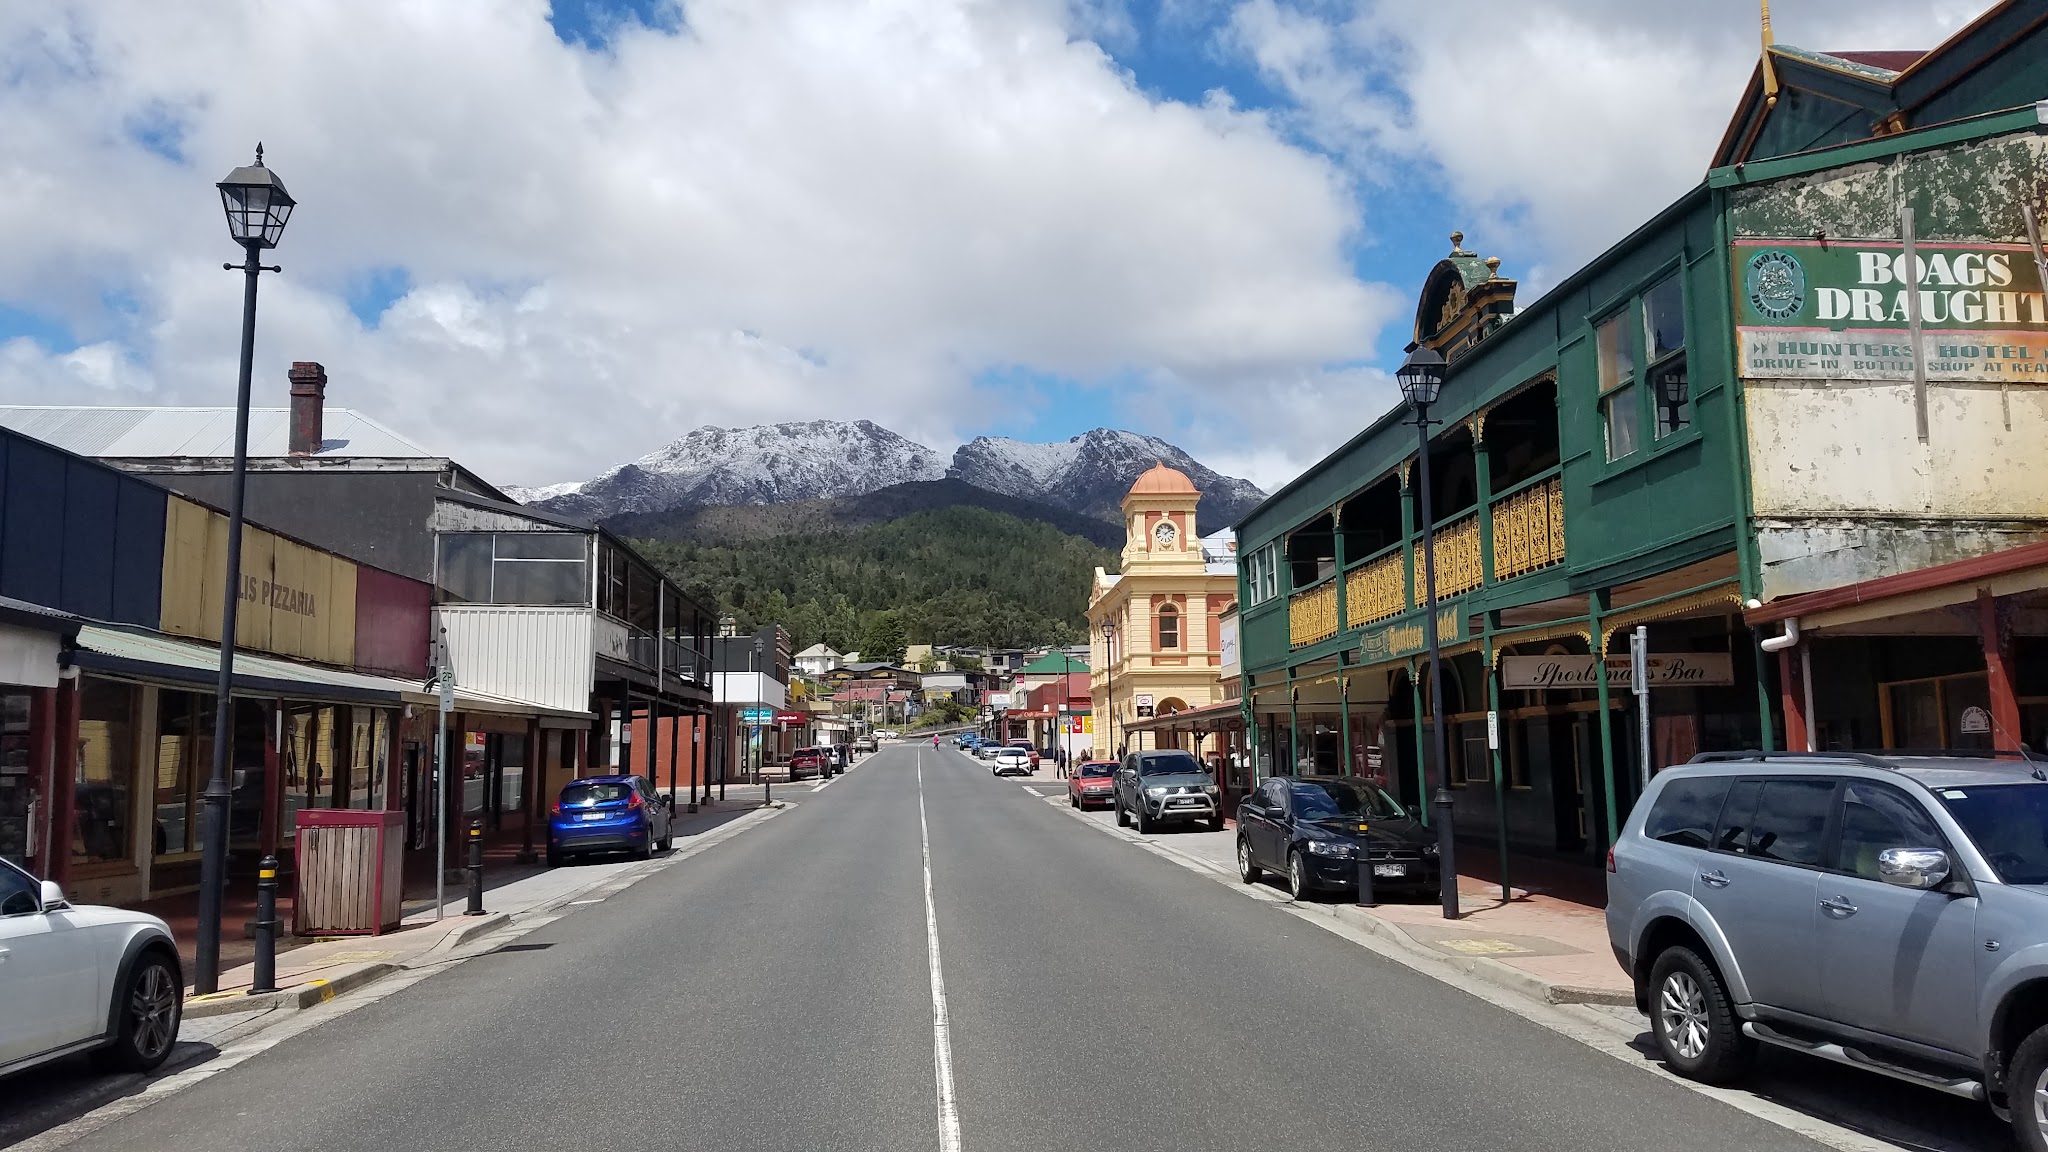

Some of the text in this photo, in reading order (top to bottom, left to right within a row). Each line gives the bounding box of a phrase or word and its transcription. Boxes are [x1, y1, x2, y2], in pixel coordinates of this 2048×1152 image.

[1753, 252, 1795, 270] BOAGS
[1855, 252, 2013, 287] BOAGS
[1814, 287, 2048, 324] DRAUGHT
[1928, 361, 1975, 372] SHOP
[1983, 362, 2004, 372] AT
[1939, 345, 2034, 359] HOTEL
[238, 573, 316, 618] LIS PIZZARIA
[1437, 604, 1459, 645] otel
[442, 671, 453, 682] 2P
[1533, 658, 1704, 687] Sportsmas Bar
